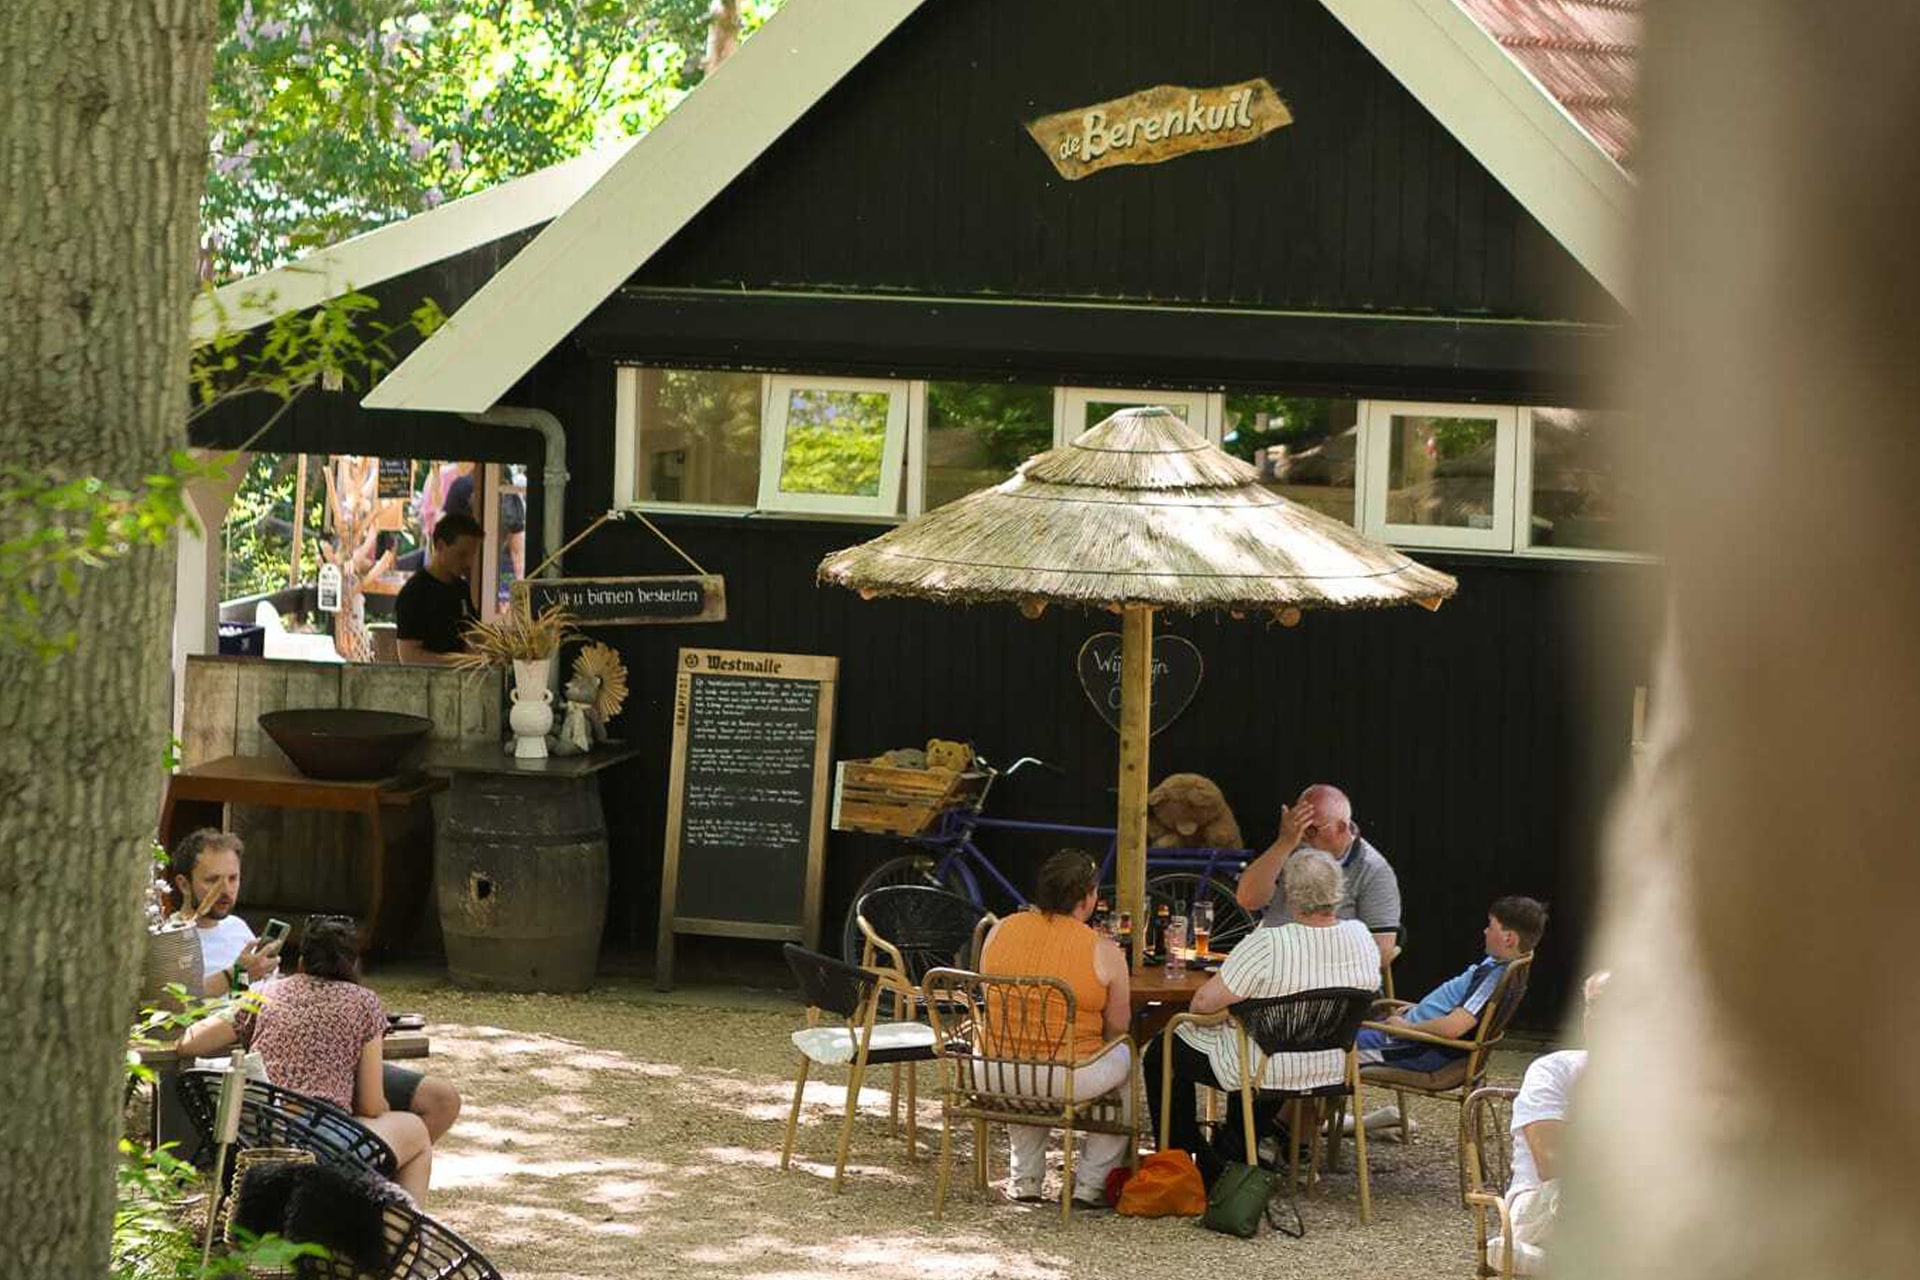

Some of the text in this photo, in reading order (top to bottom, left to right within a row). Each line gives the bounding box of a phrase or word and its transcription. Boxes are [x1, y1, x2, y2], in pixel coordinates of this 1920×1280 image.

[1059, 89, 1253, 162] de Berenkuil
[587, 588, 634, 605] binnen
[637, 587, 698, 604] bestellen
[706, 655, 783, 674] Westmalle
